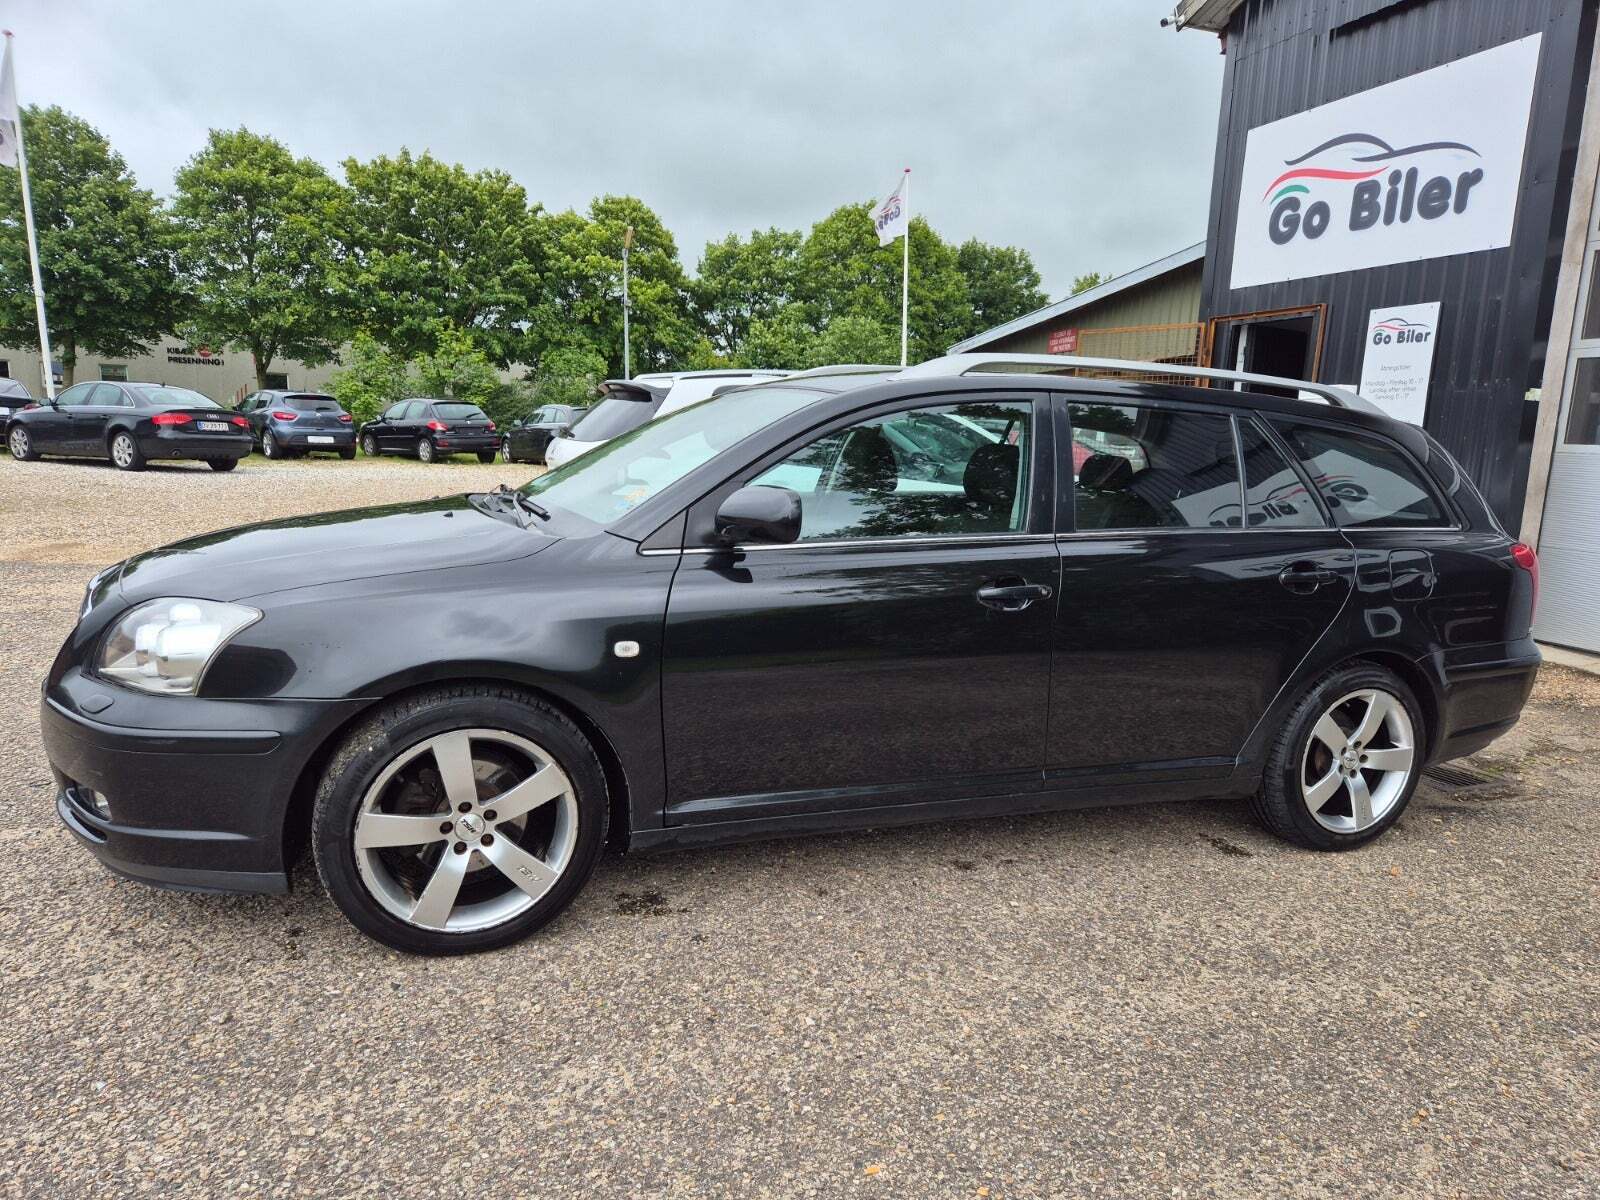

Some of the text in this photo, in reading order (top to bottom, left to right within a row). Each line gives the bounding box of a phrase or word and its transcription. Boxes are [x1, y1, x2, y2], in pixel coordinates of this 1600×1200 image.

[1268, 166, 1484, 245] Go Biler
[1373, 329, 1431, 345] Go Biler
